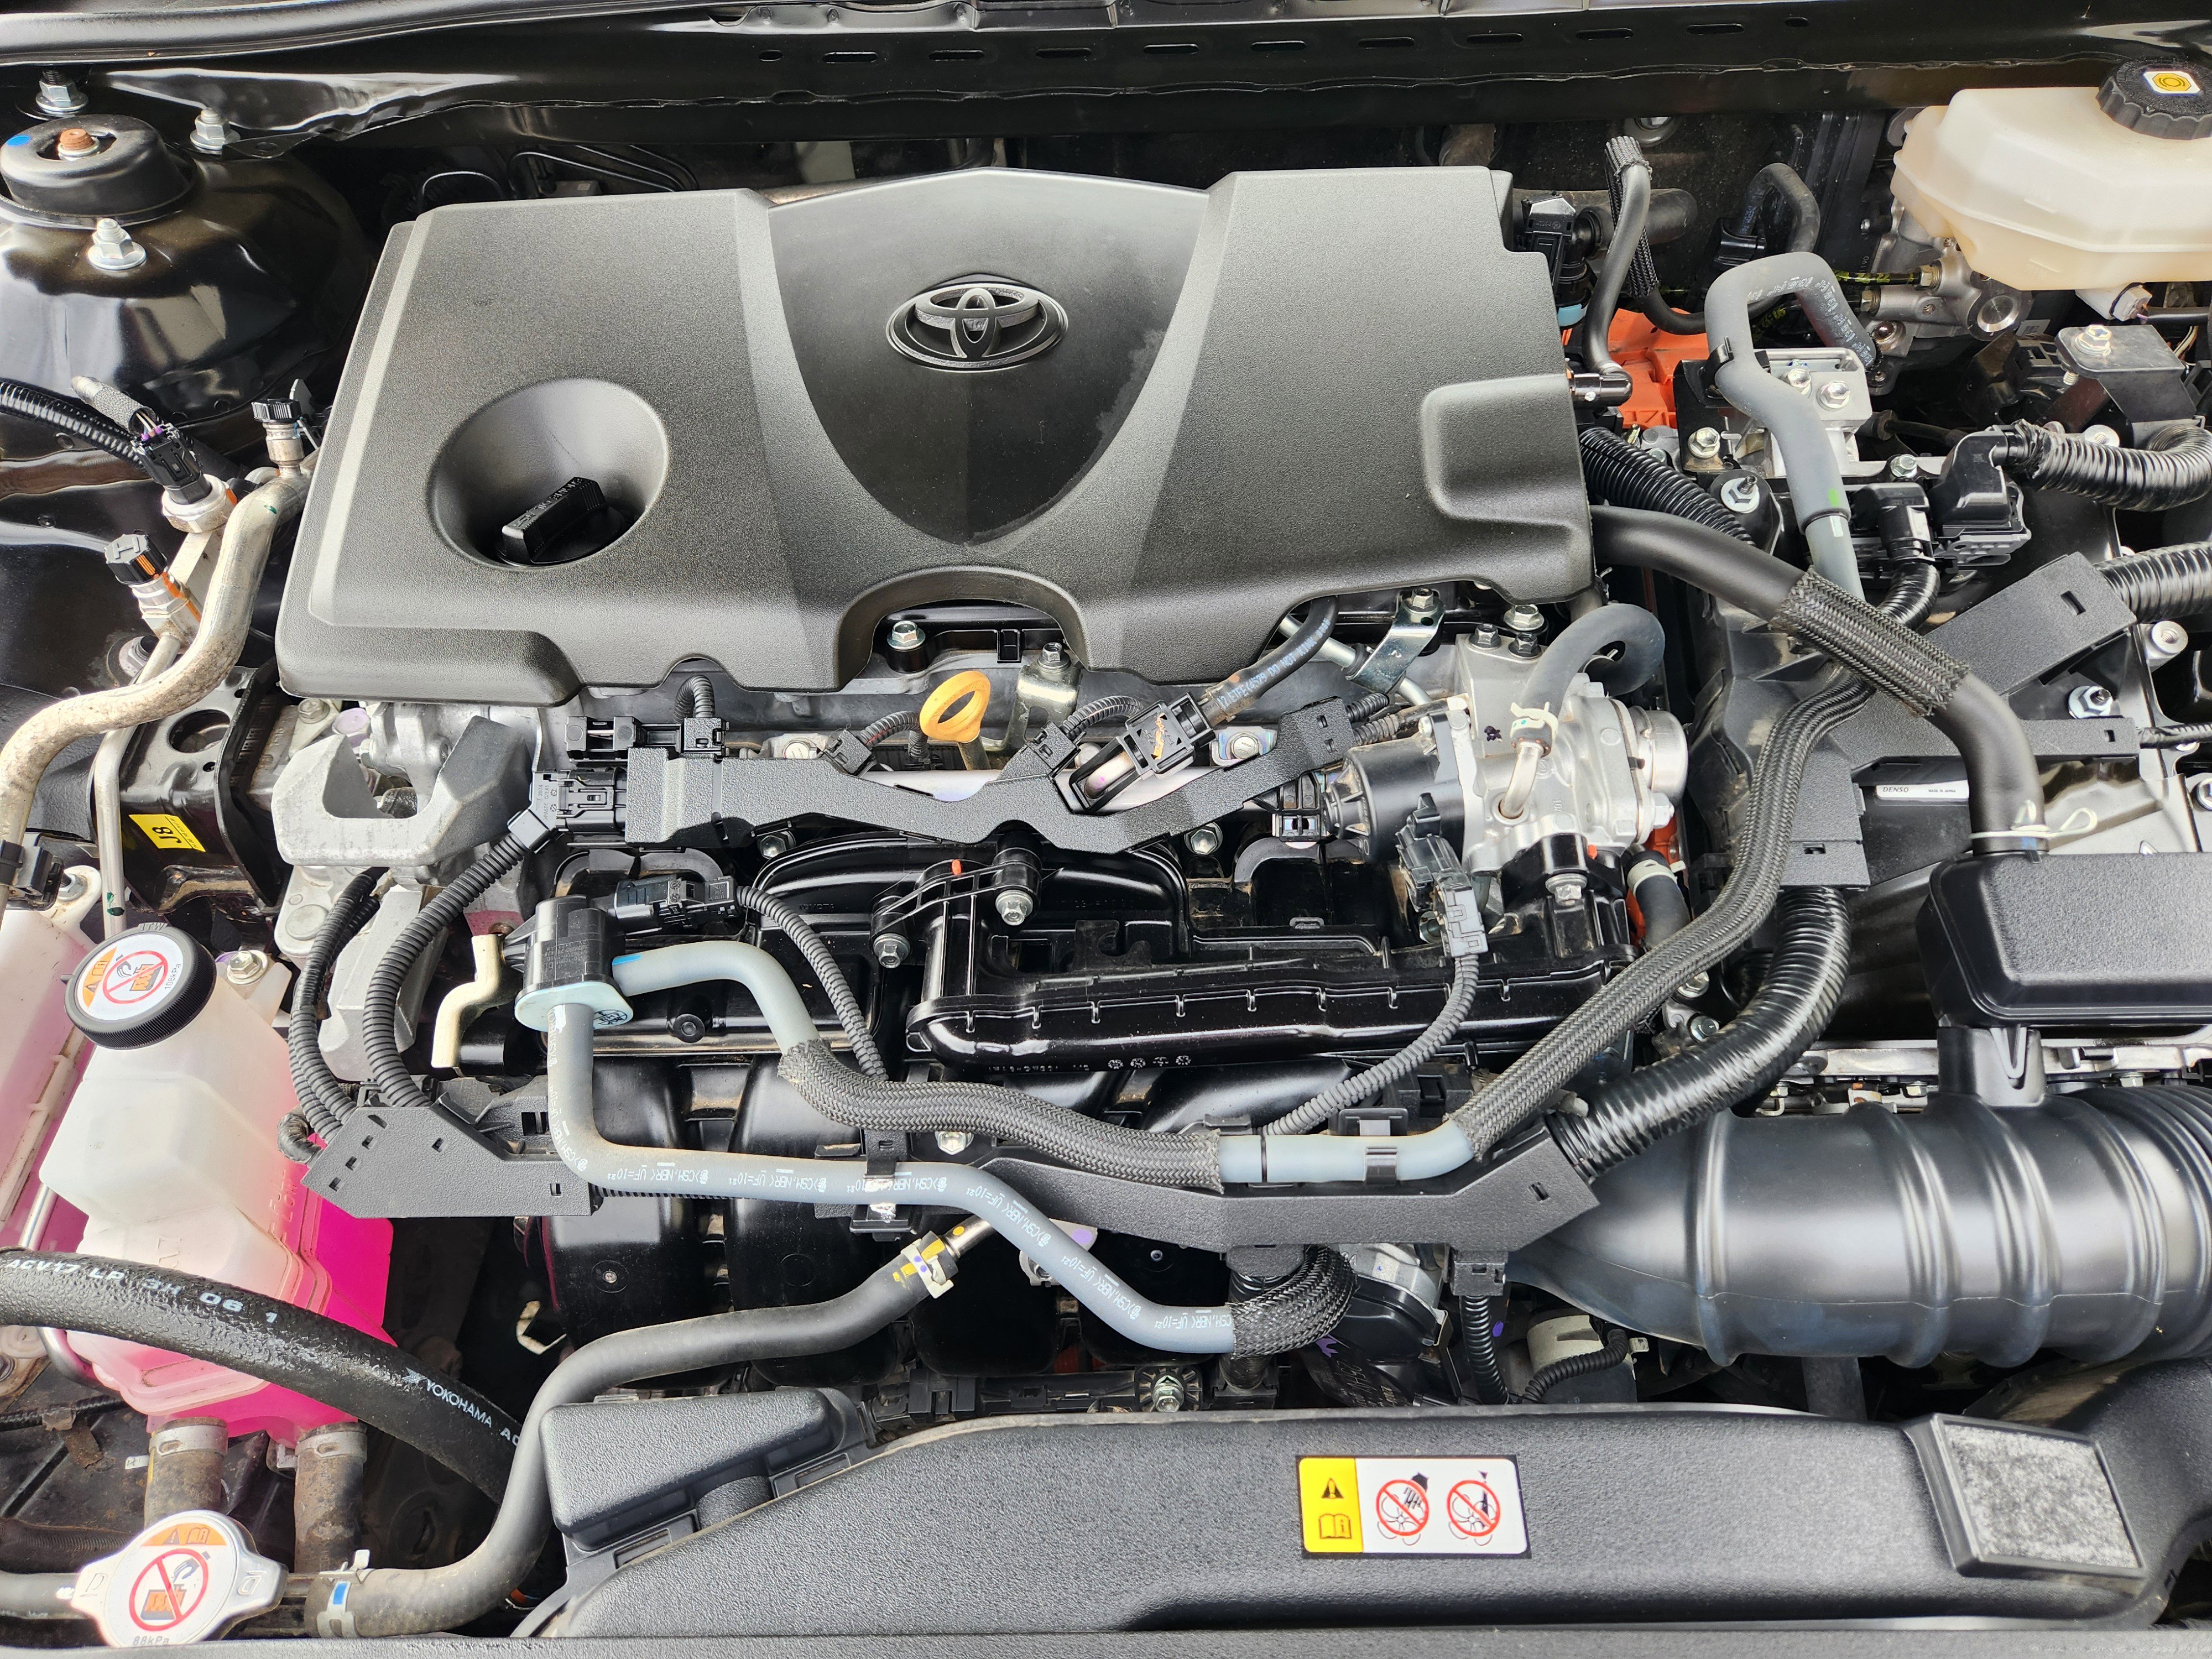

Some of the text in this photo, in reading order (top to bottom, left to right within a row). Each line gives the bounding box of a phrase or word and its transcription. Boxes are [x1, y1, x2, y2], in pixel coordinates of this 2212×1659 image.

[152, 827, 182, 843] J8
[164, 963, 181, 990] 108kPa
[90, 1268, 125, 1281] LP
[425, 1378, 492, 1428] YOKOHAMA
[133, 1636, 170, 1646] 88kPa
